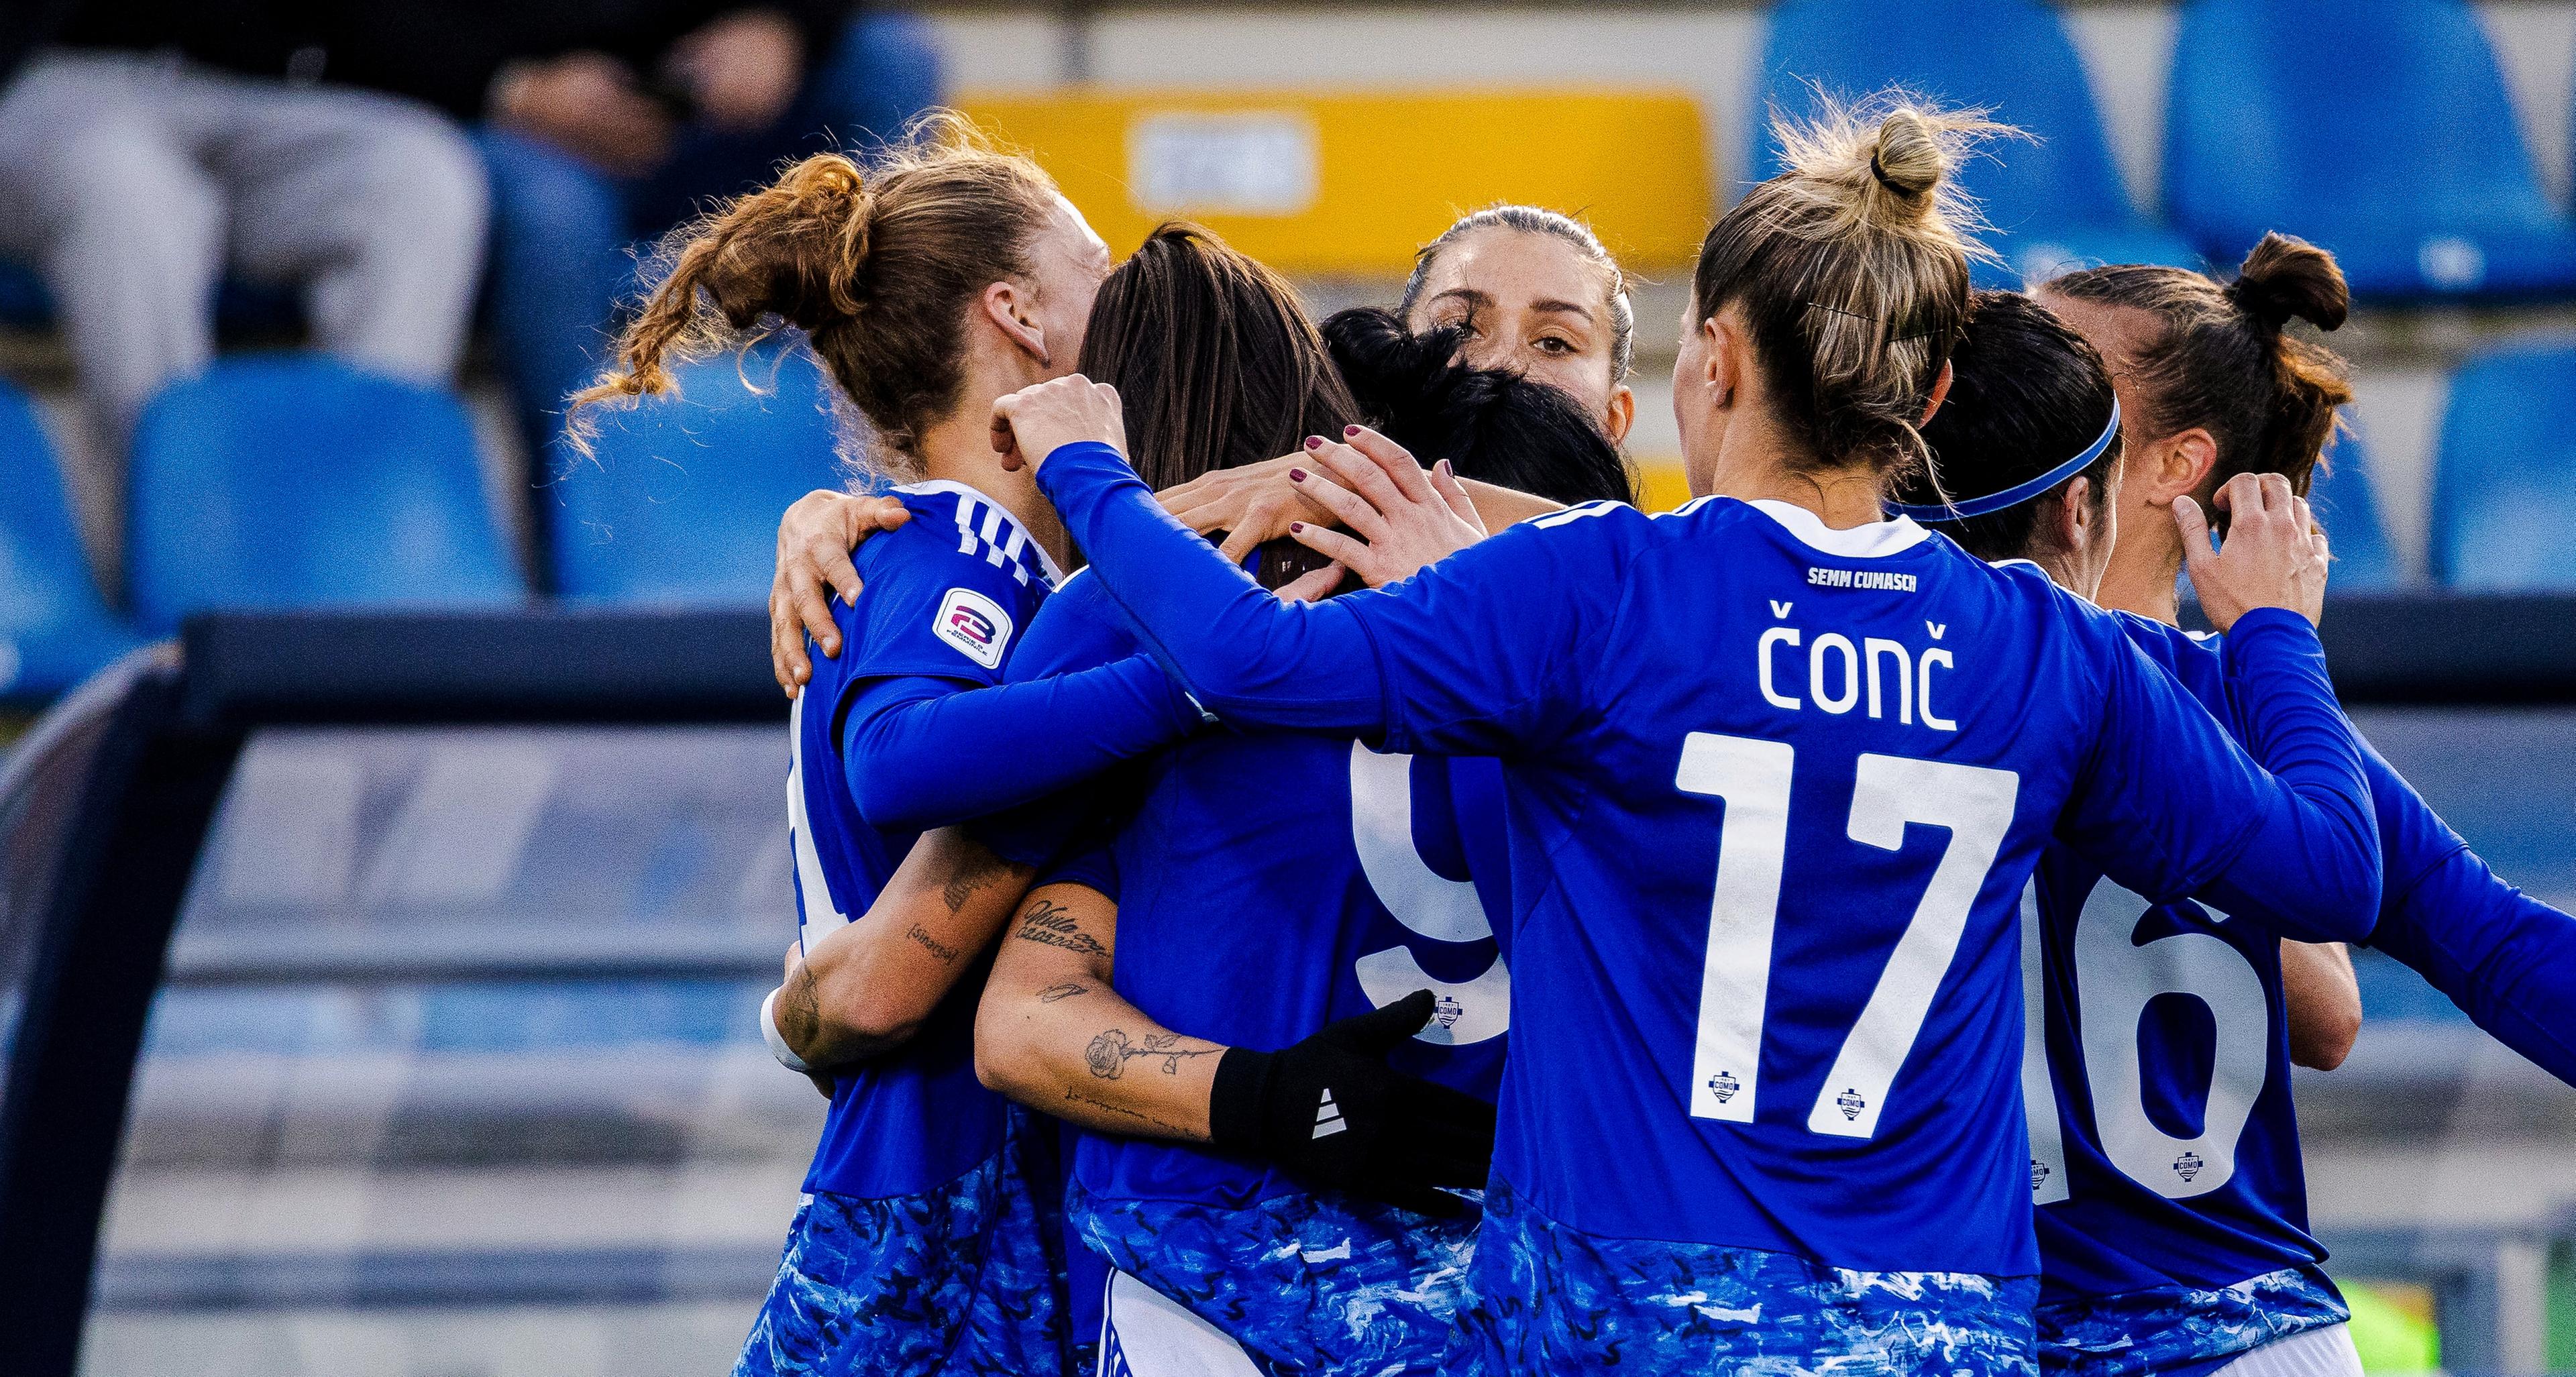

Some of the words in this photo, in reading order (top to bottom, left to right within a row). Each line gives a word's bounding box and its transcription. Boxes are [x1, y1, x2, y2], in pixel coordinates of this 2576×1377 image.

[1807, 567, 1852, 588] SEMM
[1854, 571, 1917, 593] CUMASCH
[1350, 737, 1511, 1046] 9
[1674, 730, 2021, 1140] 17
[1439, 1007, 1457, 1015] COMO
[1715, 1081, 1733, 1090] COMO
[1843, 1098, 1860, 1107] COMO
[2180, 1161, 2197, 1169] COMO
[2031, 1168, 2043, 1176] MO
